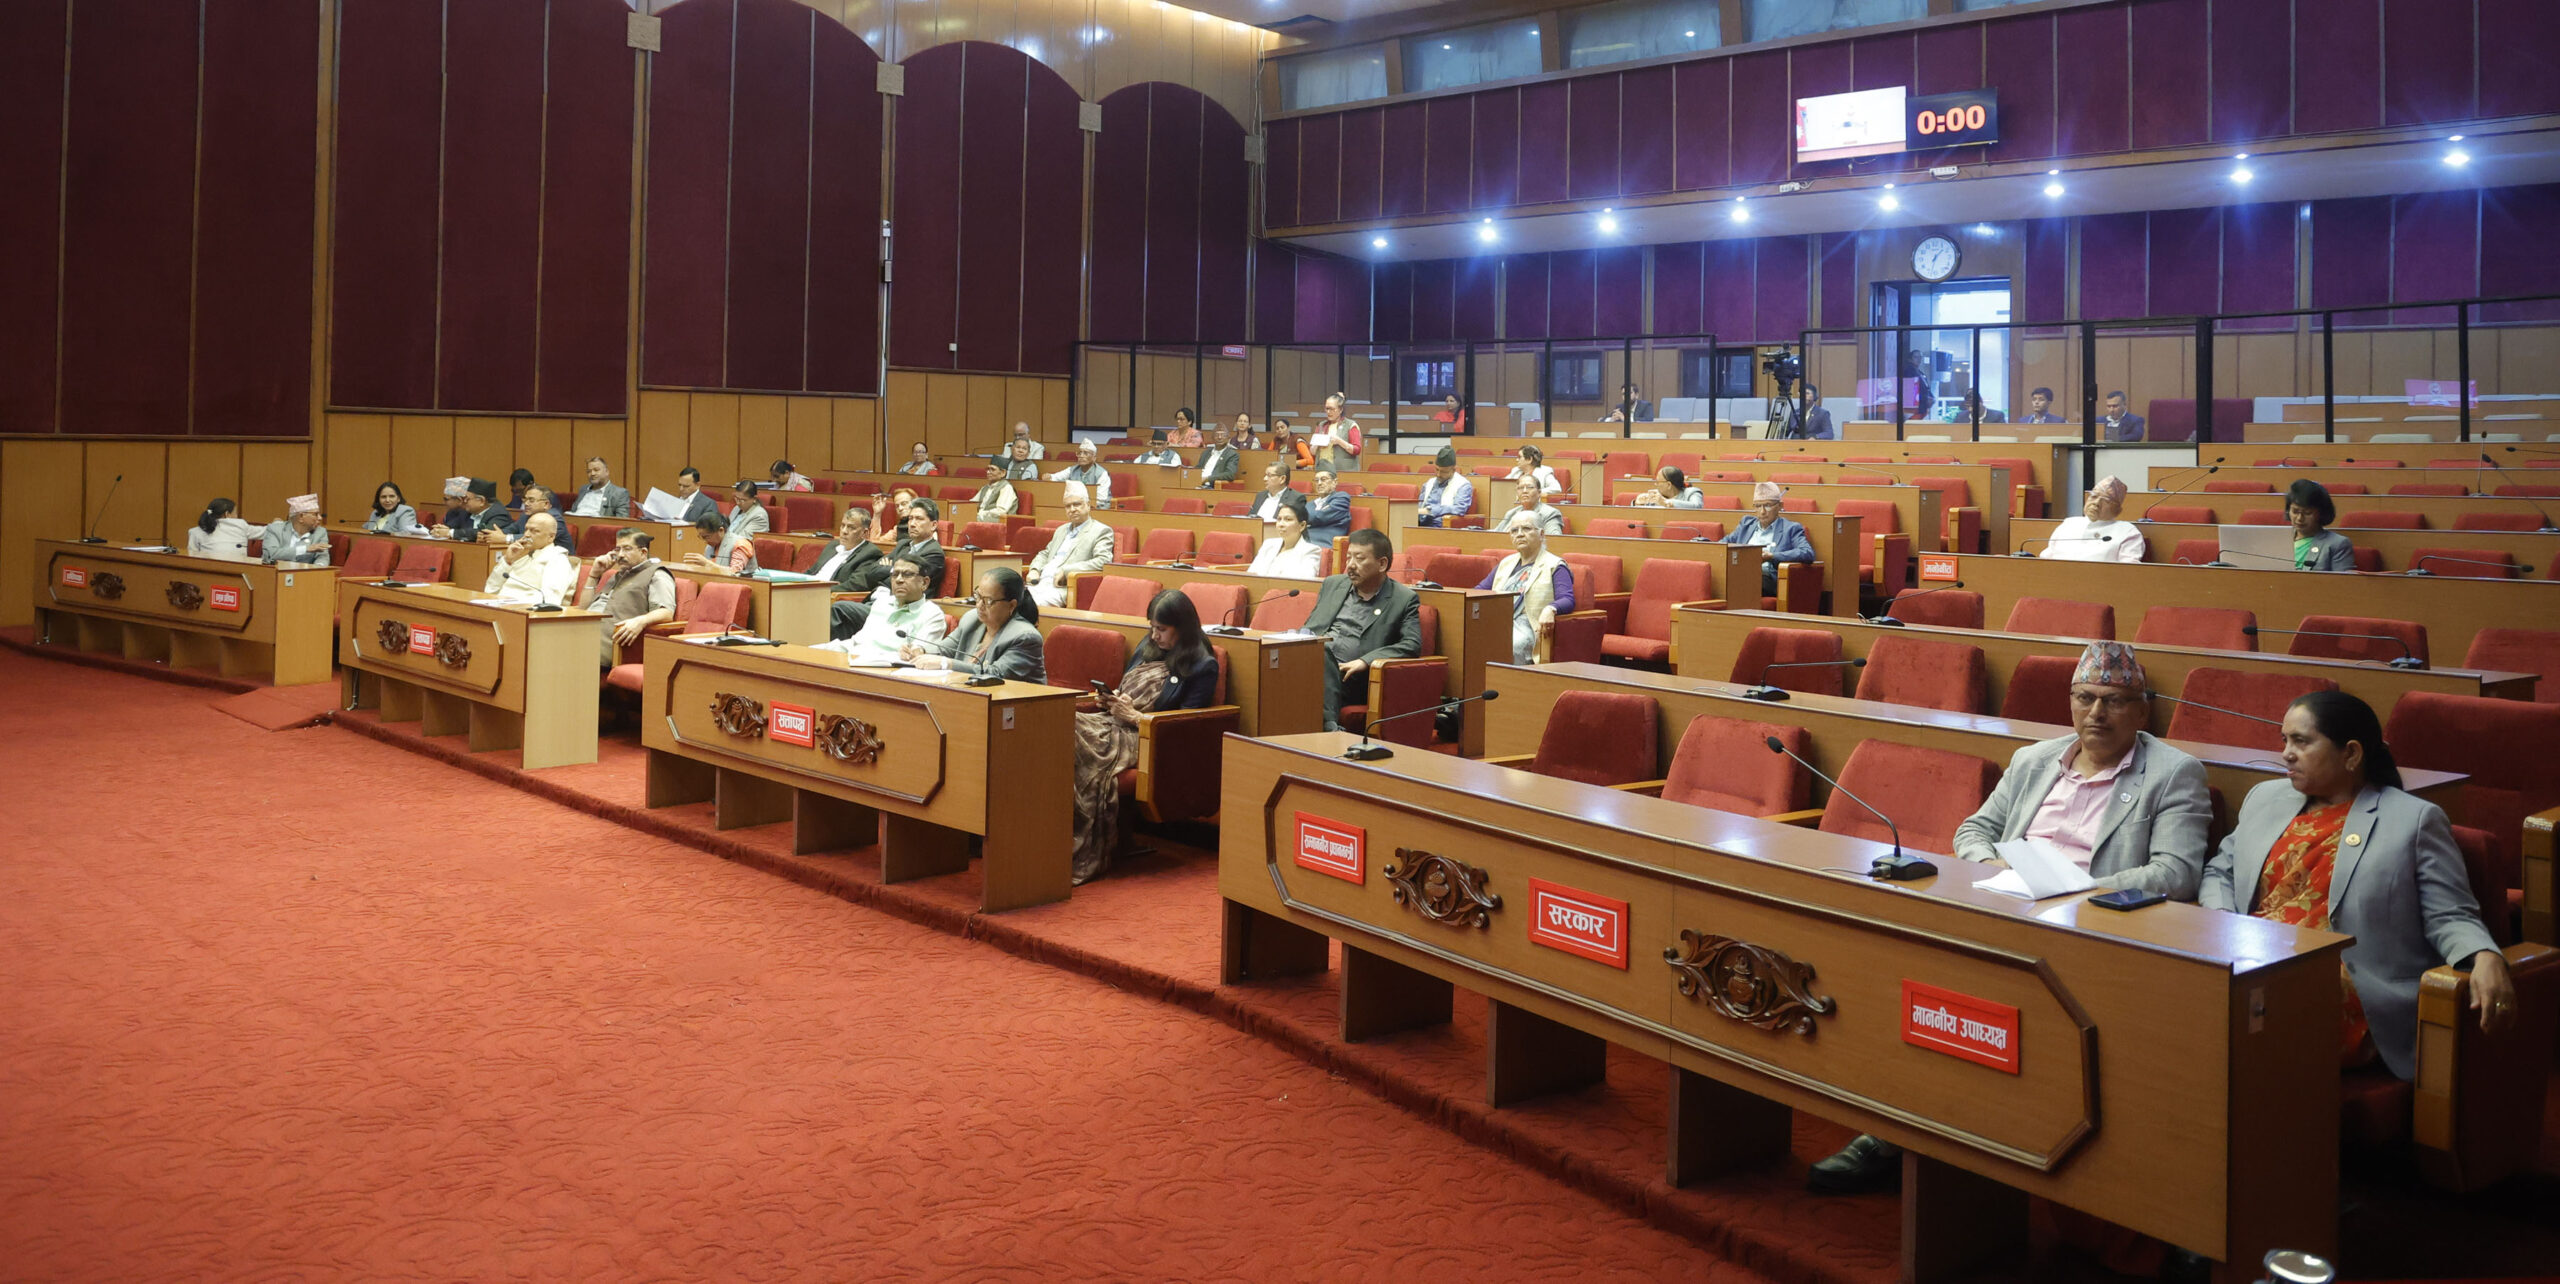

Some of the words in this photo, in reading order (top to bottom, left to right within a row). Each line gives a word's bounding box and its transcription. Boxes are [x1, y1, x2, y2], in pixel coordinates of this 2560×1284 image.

[1917, 105, 1986, 135] 0:00
[1548, 903, 1607, 938] सरकार
[1912, 1004, 1957, 1035] माननीय
[1960, 1018, 2008, 1050] उपाध्यक्ष
